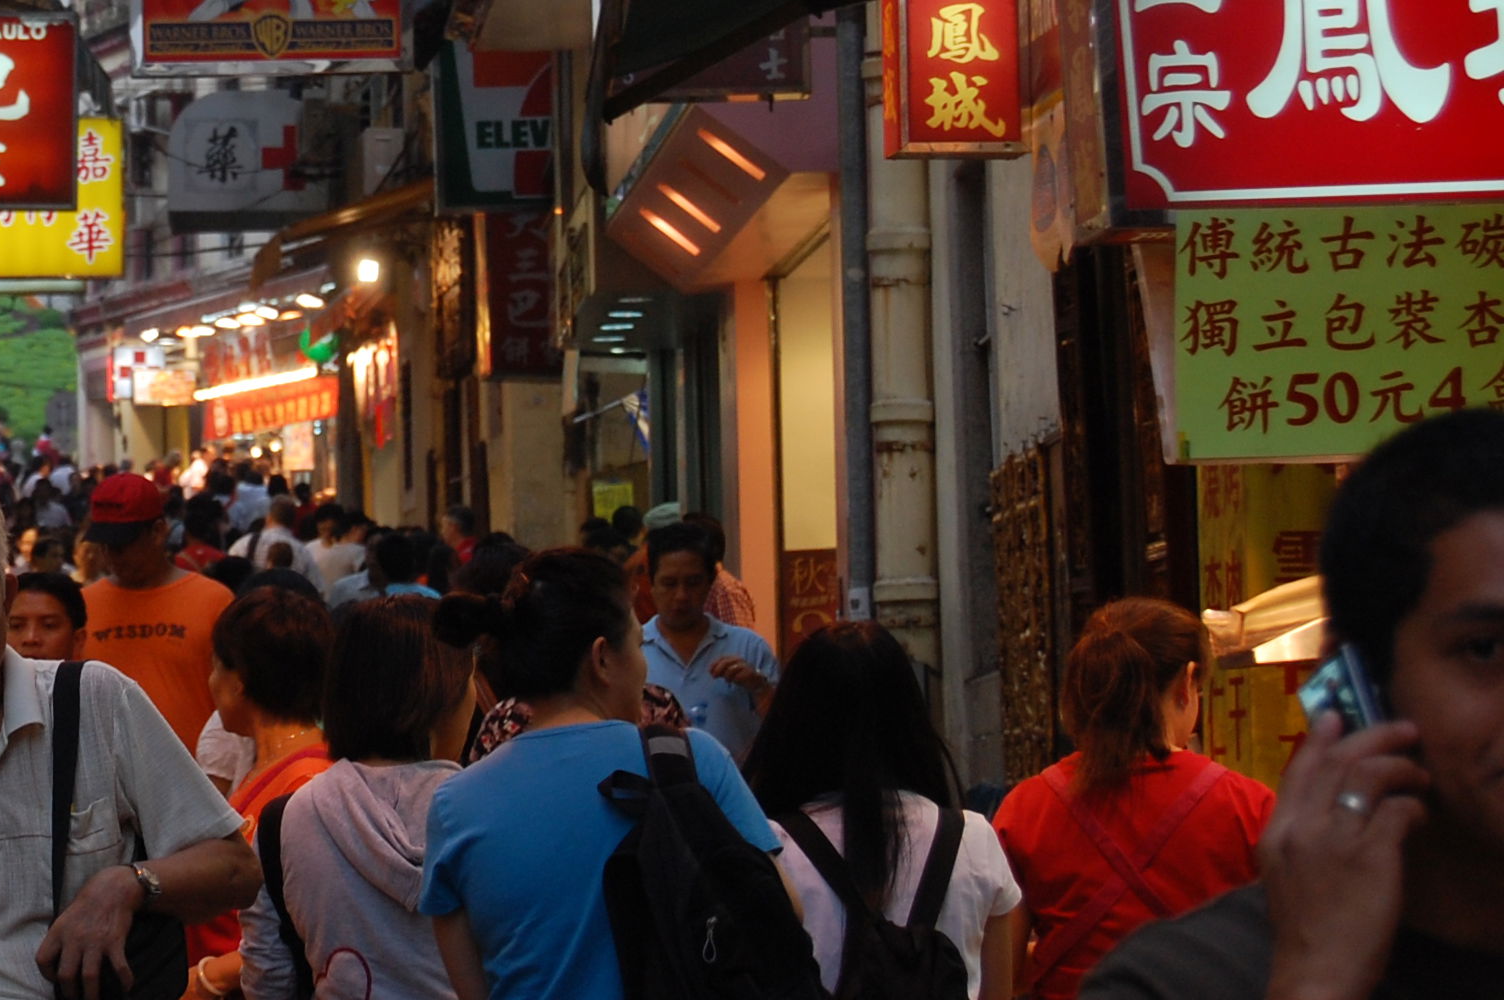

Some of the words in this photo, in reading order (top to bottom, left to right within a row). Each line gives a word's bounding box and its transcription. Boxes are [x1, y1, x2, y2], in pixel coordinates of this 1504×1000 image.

[198, 126, 244, 184] 藥
[67, 130, 114, 264] 嘉華
[1180, 290, 1504, 358] 獨立包裝杏
[92, 622, 187, 641] WISDOM
